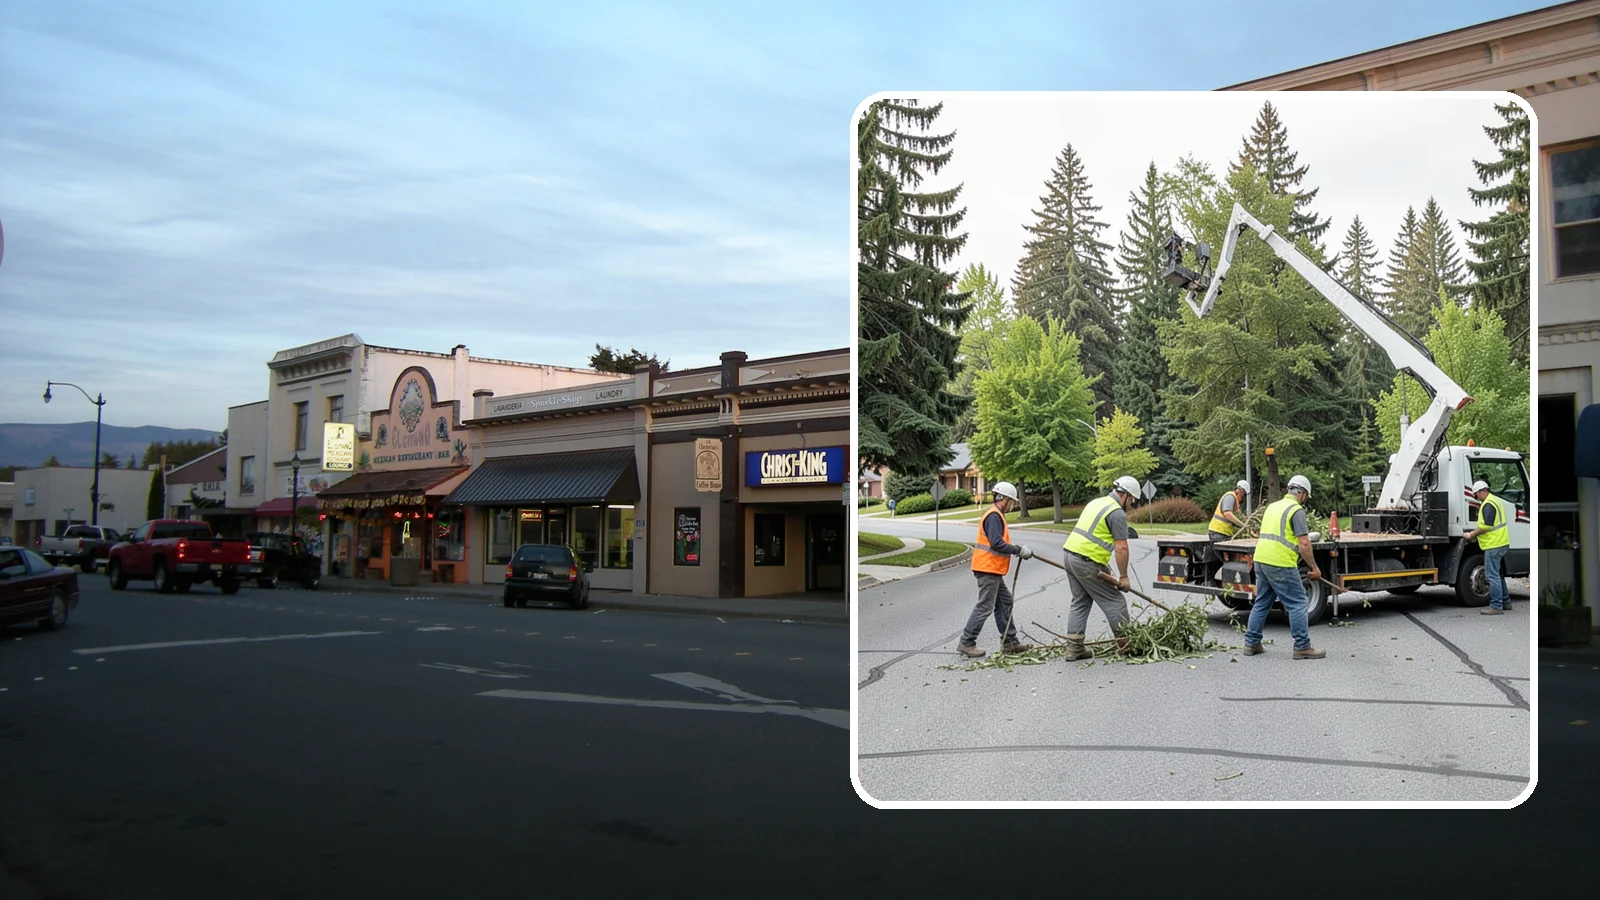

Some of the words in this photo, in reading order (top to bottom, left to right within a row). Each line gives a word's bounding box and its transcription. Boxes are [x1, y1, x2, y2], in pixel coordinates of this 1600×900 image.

[562, 394, 583, 406] Shop
[595, 389, 623, 400] LAUNDRY
[493, 402, 522, 412] LAVANDERIA
[397, 451, 433, 462] RESTAURANT
[438, 449, 450, 459] BAR
[760, 452, 797, 478] CHRIST
[799, 450, 827, 477] KING
